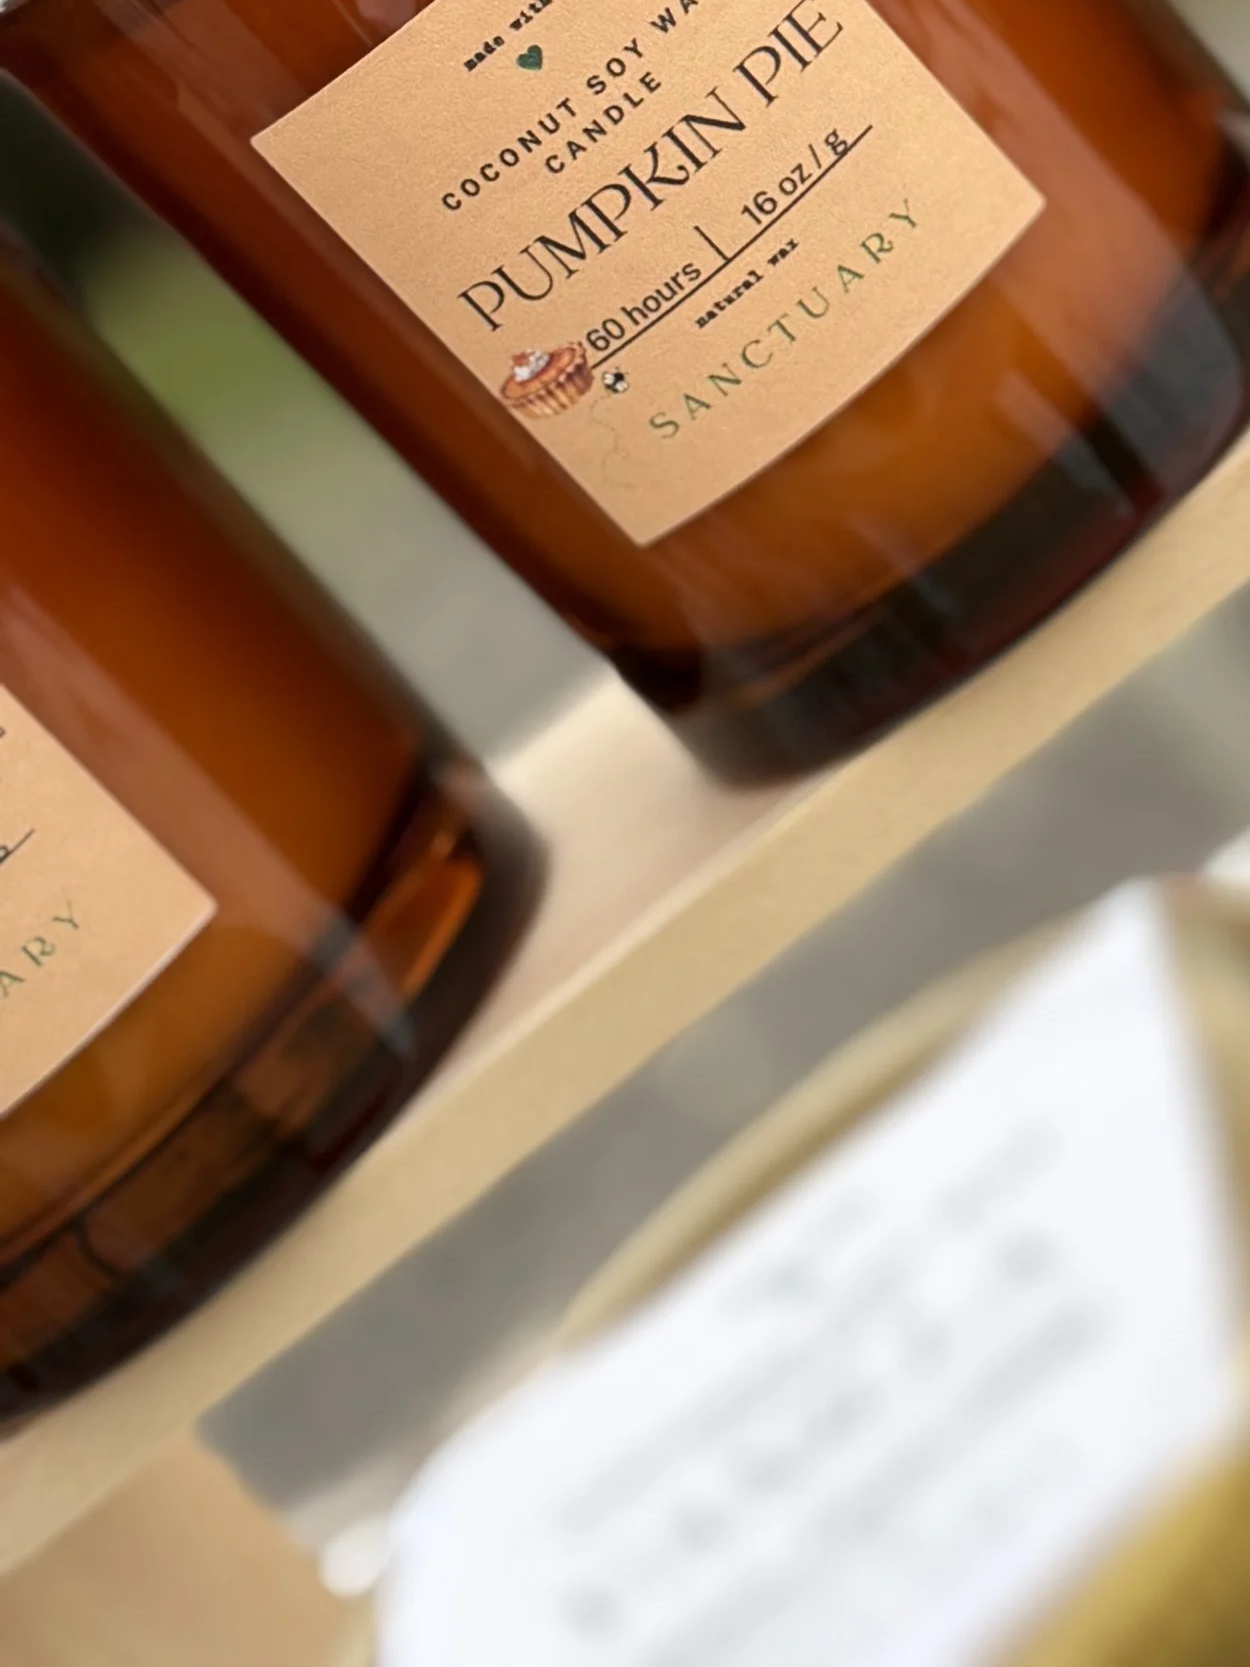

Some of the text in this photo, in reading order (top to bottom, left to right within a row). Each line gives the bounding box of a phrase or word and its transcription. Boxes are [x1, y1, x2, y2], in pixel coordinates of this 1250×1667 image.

[441, 97, 576, 211] COCONUT
[586, 38, 643, 95] SOY
[463, 36, 505, 72] made
[545, 71, 661, 174] CANDLE
[457, 87, 746, 332] PUMPKIN
[586, 318, 625, 351] 60
[622, 263, 701, 329] hours
[740, 190, 778, 225] 16
[695, 239, 799, 329] natural wax
[649, 197, 918, 438] SANCTUARY
